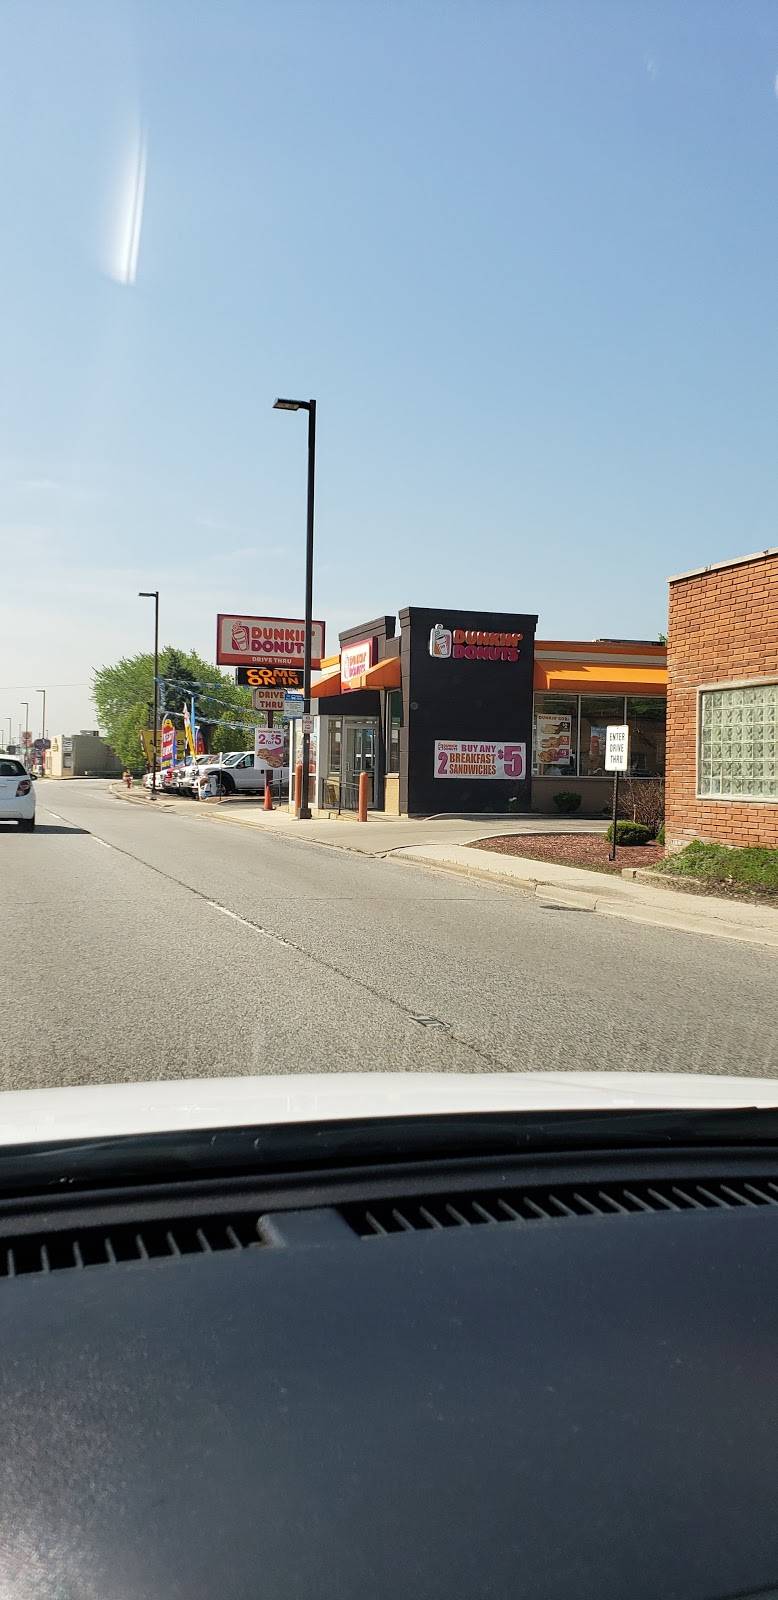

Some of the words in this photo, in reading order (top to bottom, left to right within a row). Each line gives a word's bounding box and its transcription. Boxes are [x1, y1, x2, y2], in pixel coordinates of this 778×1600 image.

[452, 629, 523, 647] DUNKIN'
[251, 640, 304, 653] DONUT
[452, 645, 519, 662] DONUTS
[246, 669, 297, 678] COME
[247, 677, 277, 686] ON
[281, 677, 299, 685] IN
[258, 691, 284, 699] DRIVE
[609, 732, 625, 741] ENTER
[461, 744, 478, 753] BUY
[479, 744, 497, 753] ANY
[609, 743, 624, 753] DRIVE
[437, 751, 449, 775] 2
[449, 753, 497, 765] BREAKFAST
[610, 754, 624, 764] THRU
[449, 763, 497, 775] SANDWICHES
